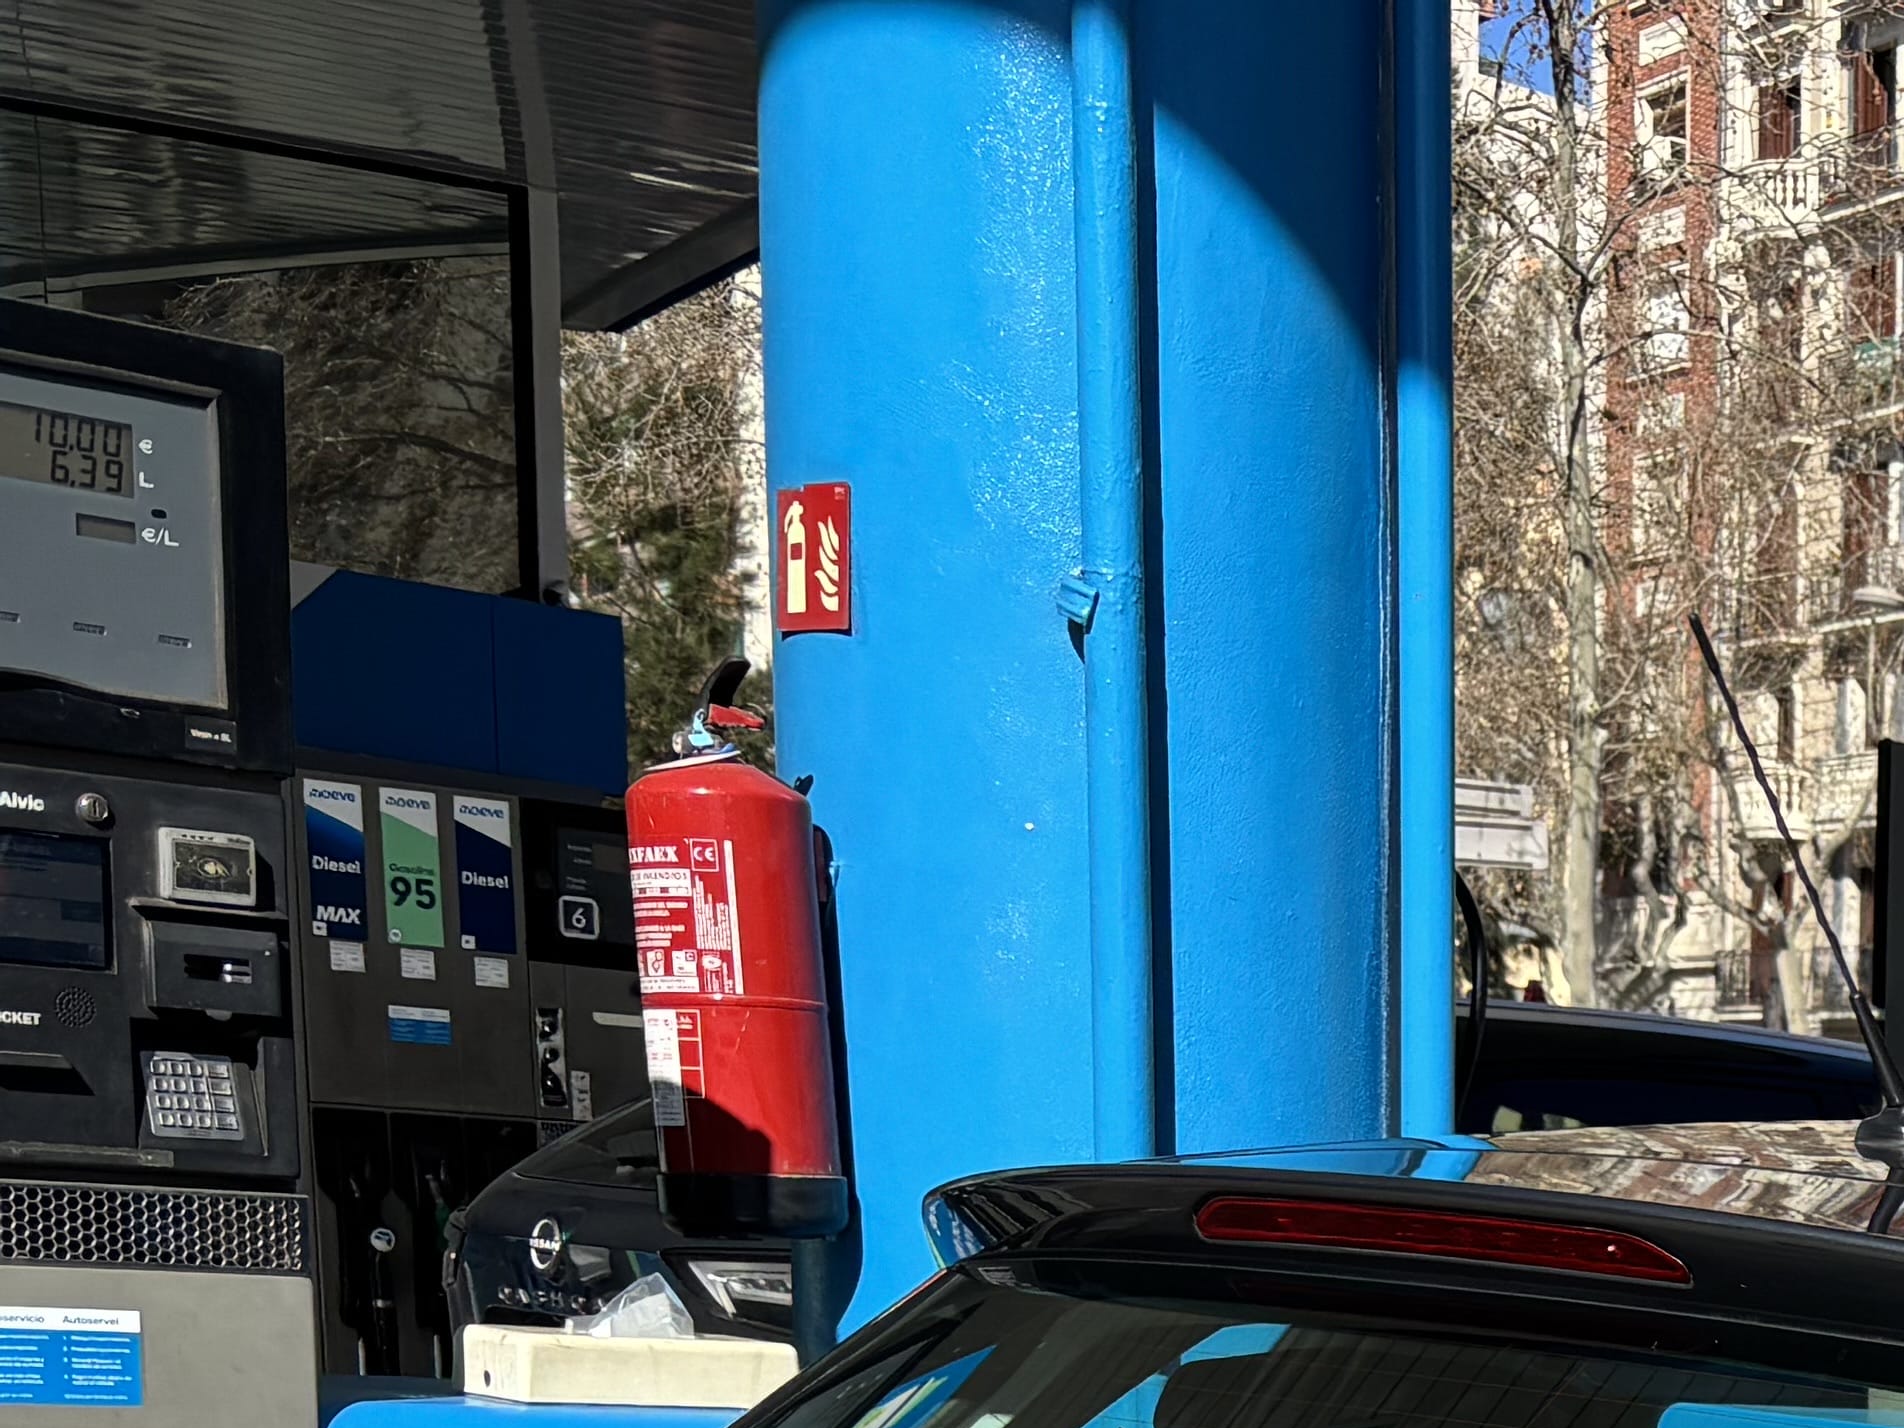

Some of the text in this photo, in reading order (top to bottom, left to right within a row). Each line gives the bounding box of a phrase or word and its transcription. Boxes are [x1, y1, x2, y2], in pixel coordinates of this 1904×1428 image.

[139, 471, 154, 488] L
[141, 527, 180, 547] €/L
[312, 855, 361, 874] Diesel
[461, 870, 510, 889] Diesel
[390, 876, 436, 910] 95
[316, 905, 361, 925] MAX
[572, 907, 586, 929] 6
[0, 1315, 45, 1323] servicio
